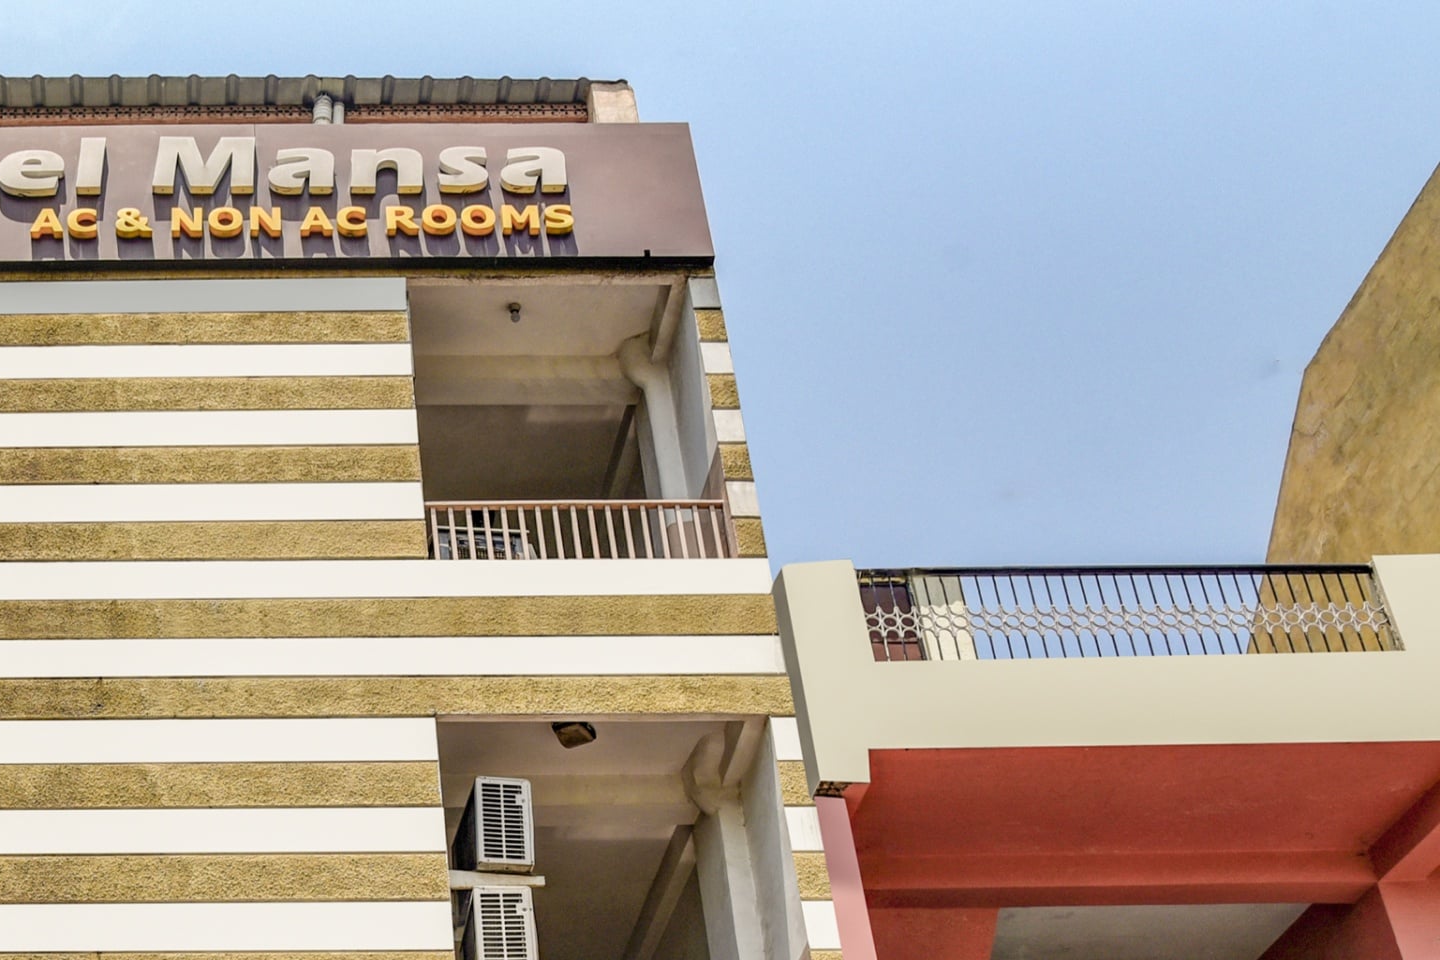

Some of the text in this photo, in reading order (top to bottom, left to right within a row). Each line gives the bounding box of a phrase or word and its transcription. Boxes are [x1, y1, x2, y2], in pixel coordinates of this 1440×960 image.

[152, 136, 567, 195] Mansa
[30, 204, 575, 239] AC & NON AC ROOMS
